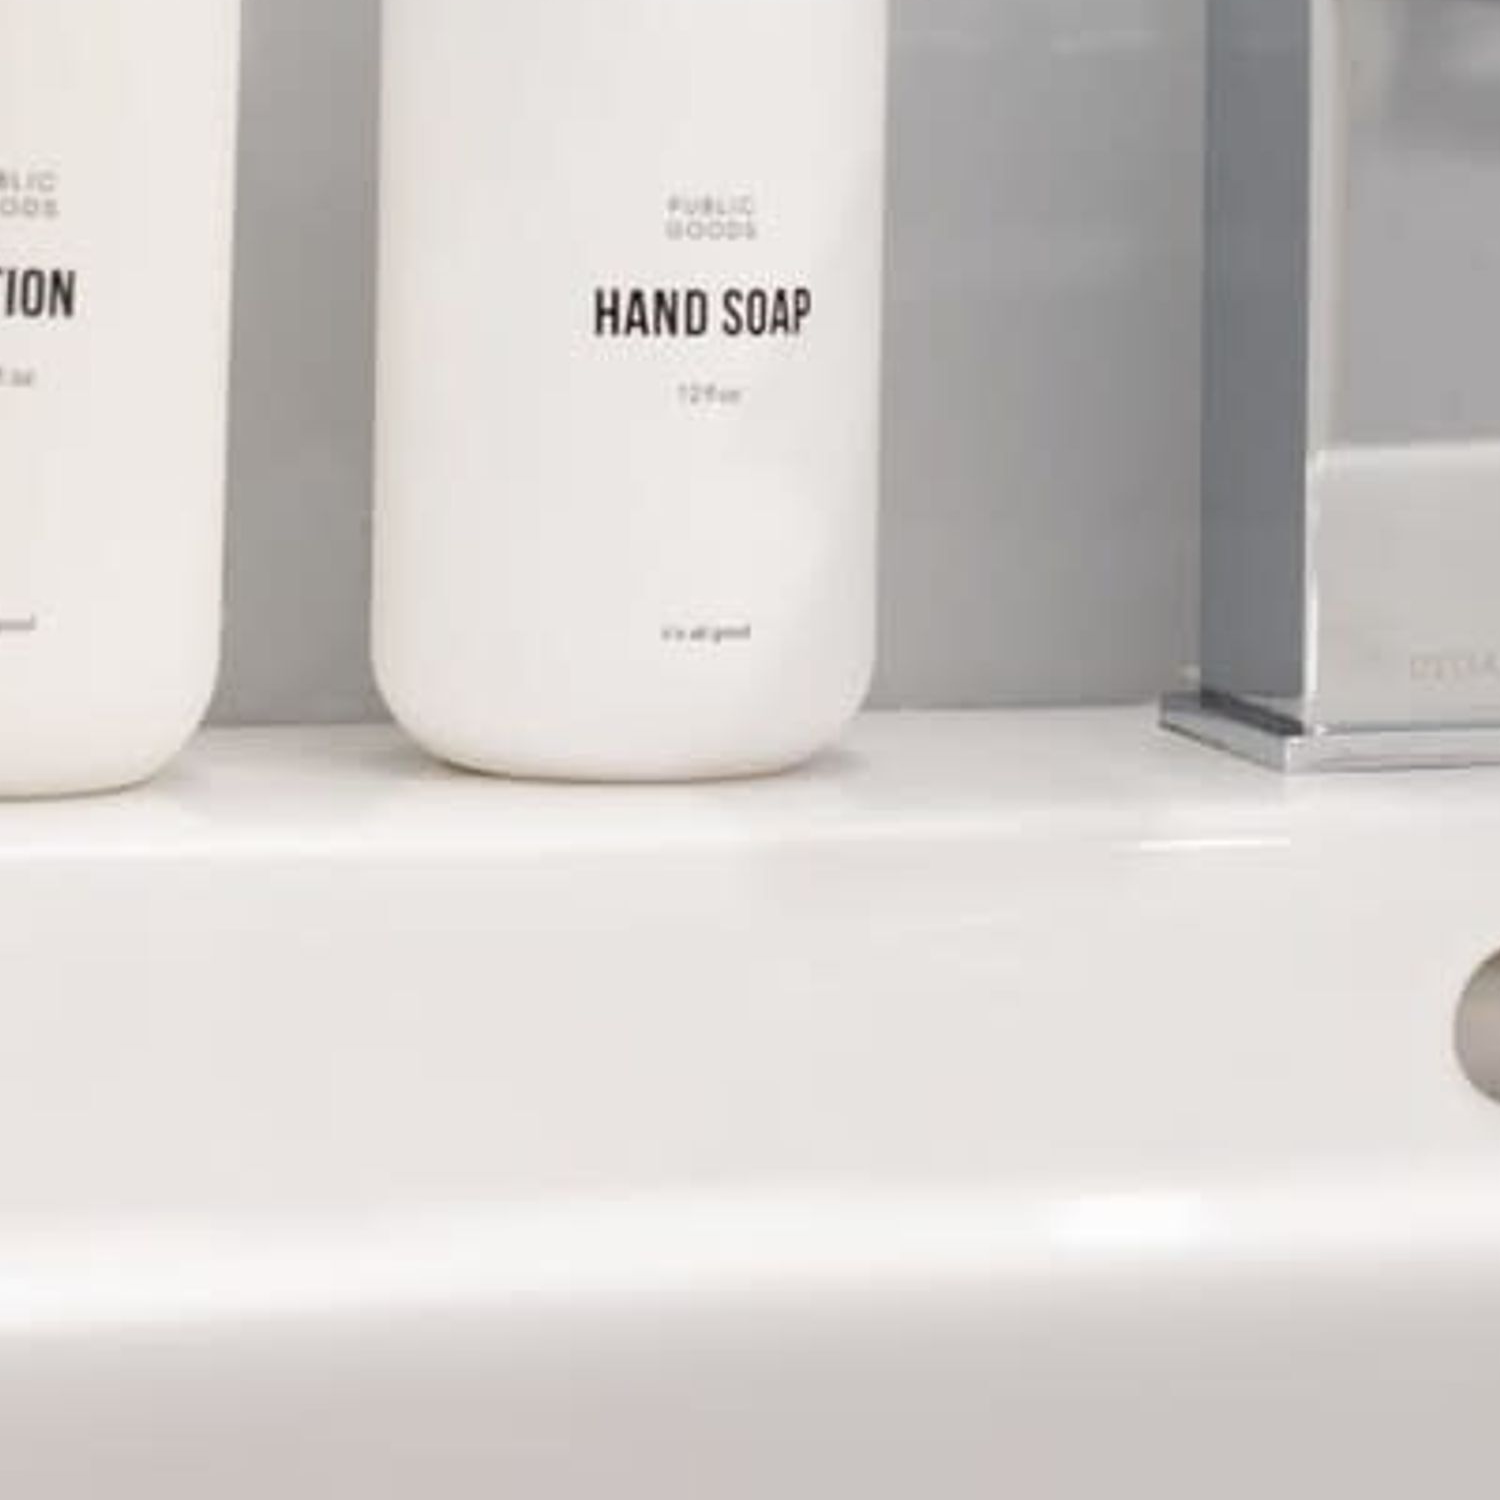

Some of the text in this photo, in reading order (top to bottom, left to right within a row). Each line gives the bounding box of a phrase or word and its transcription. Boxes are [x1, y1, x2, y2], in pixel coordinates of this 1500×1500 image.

[667, 195, 753, 216] PUBLIC
[665, 219, 757, 241] GOODS
[0, 267, 76, 319] ION
[594, 285, 812, 337] HAND SOAP
